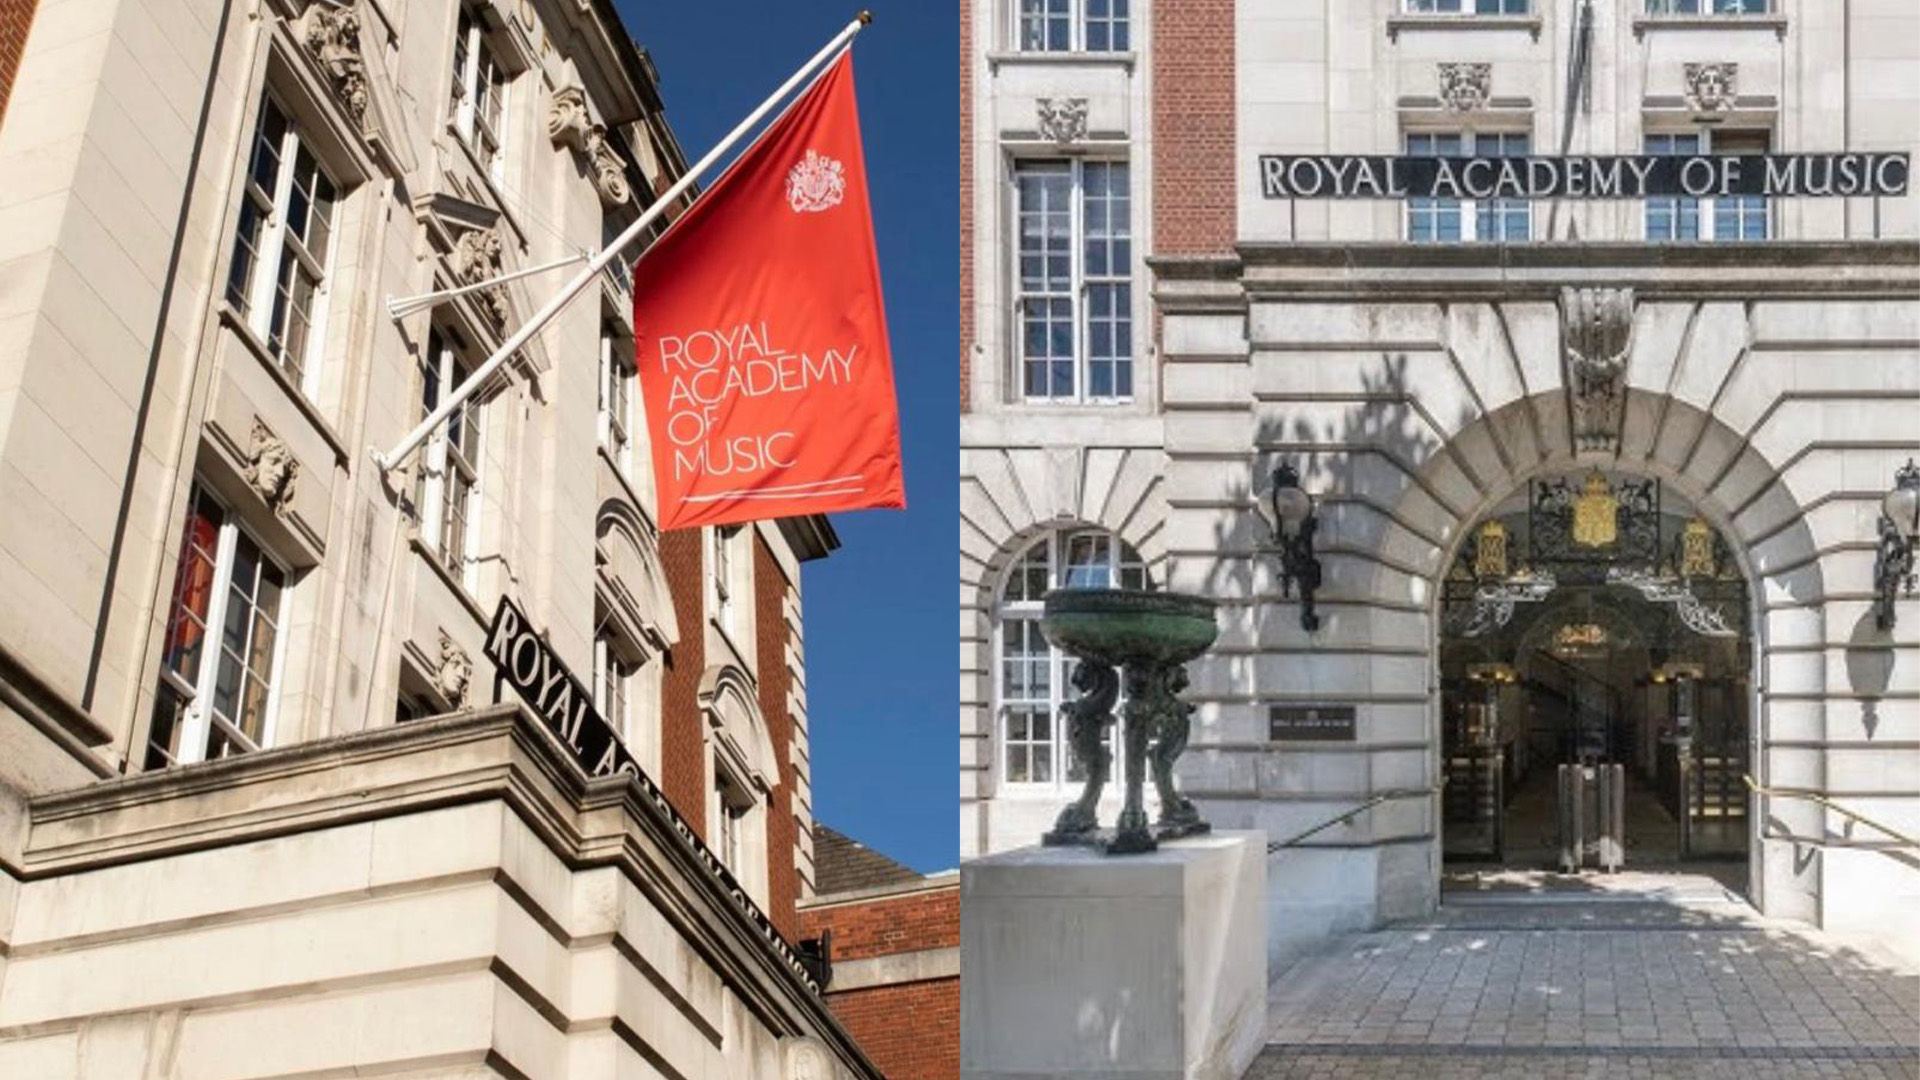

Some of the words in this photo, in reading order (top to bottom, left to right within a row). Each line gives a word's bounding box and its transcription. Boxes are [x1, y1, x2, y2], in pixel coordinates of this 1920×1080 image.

[1265, 157, 1407, 197] ROYAL
[1430, 157, 1655, 197] ACADEMY
[1680, 157, 1742, 195] OF
[1763, 154, 1908, 195] MUSIC
[659, 321, 786, 373] ROYAL
[667, 344, 858, 412] ACADEMY
[667, 405, 719, 446] OF
[673, 431, 797, 481] MUSIC
[490, 600, 587, 755] ROYAL
